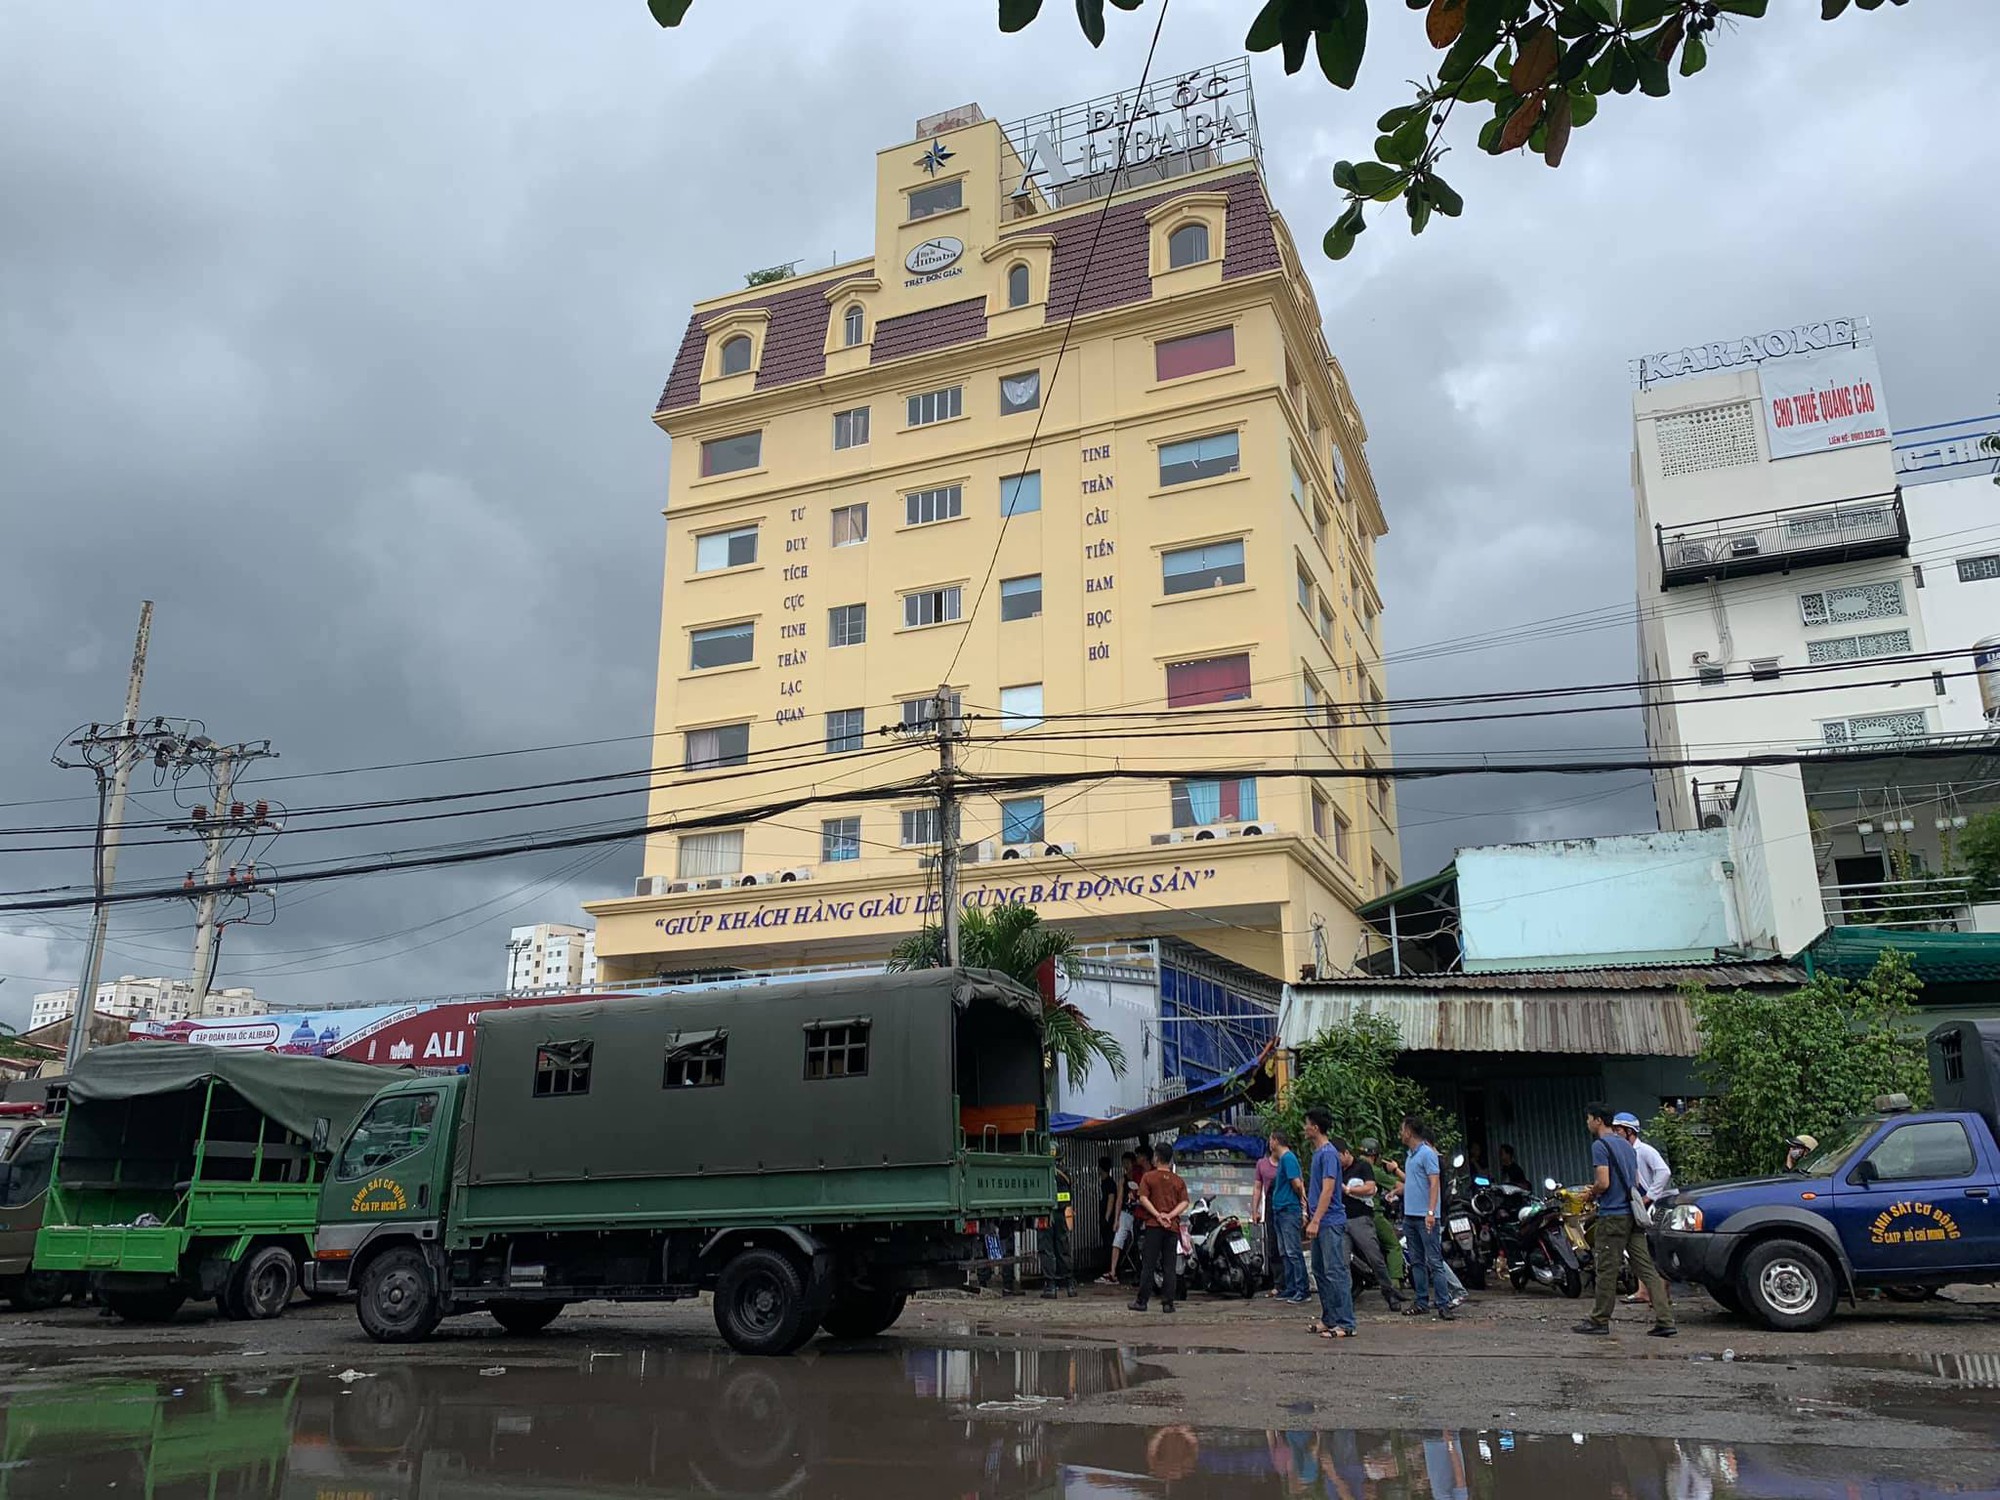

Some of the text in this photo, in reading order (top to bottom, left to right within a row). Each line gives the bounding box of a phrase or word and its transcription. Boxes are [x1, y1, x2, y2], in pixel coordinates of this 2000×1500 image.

[1172, 71, 1229, 108] ỐC
[1011, 105, 1247, 198] ALIBABA
[1643, 318, 1852, 382] KARAOKE
[1773, 377, 1875, 428] CHO THUÊ QUẢNG CÁO
[1082, 444, 1110, 462] TINH
[790, 505, 806, 521] TƯ
[786, 537, 808, 552] DUY
[783, 564, 808, 581] TÍCH
[1086, 575, 1114, 593] HAM
[783, 593, 805, 611] CỰC
[1087, 609, 1112, 629] HỌC
[780, 622, 806, 639] TINH
[780, 680, 802, 696] LẠC
[776, 706, 805, 725] QUAN
[716, 905, 789, 931] KHÁCH
[793, 899, 854, 924] HÀNG
[859, 893, 911, 918] GIÀU
[914, 891, 944, 913] LÊ
[961, 884, 1026, 909] CÙNG
[1029, 875, 1073, 903] BẤT
[1076, 875, 1144, 902] ĐỘNG
[248, 1029, 275, 1039] ALIBABA
[423, 1031, 464, 1058] ALI
[977, 1178, 1040, 1189] MITSUBISHI
[1868, 1201, 1960, 1243] CẢNH SÁT CƠ ĐỘNG
